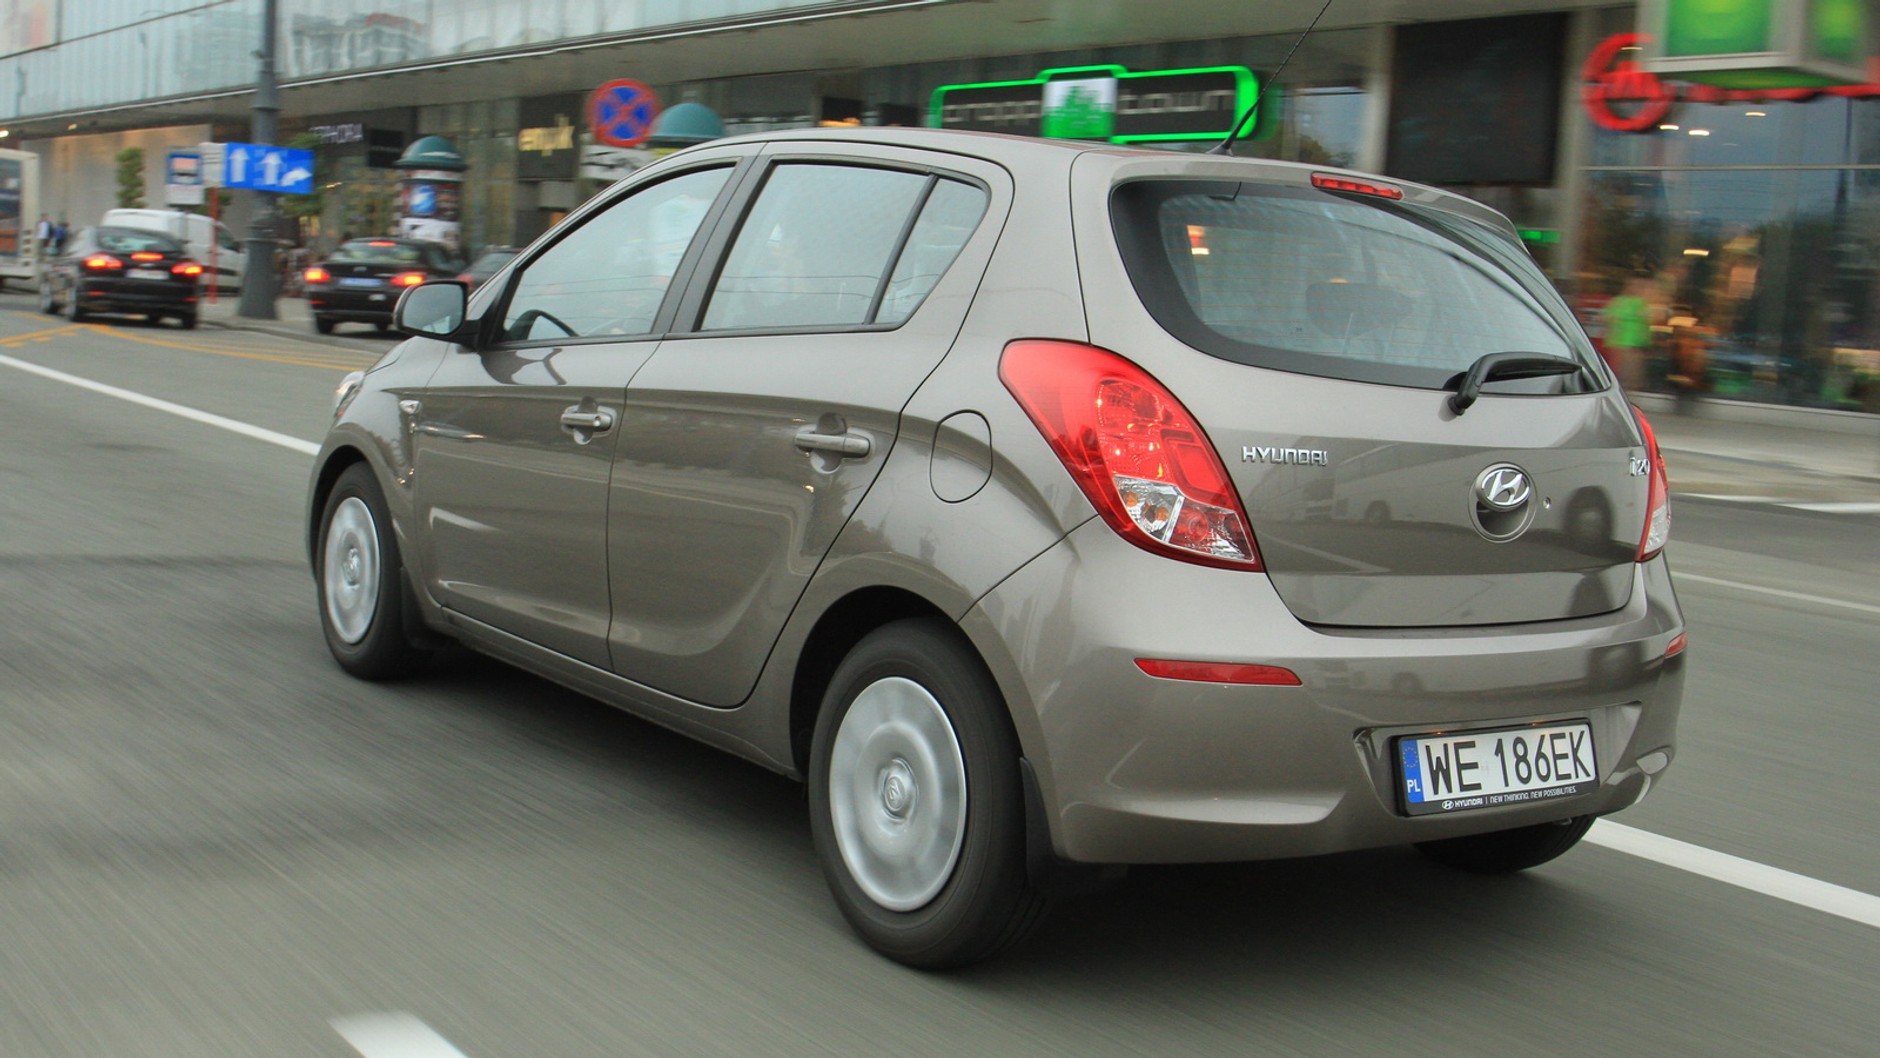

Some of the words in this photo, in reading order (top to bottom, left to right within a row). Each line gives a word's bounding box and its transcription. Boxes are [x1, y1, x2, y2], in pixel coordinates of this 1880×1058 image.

[1241, 446, 1329, 466] HYUNDAI
[1425, 740, 1482, 796] WE
[1494, 730, 1591, 788] 186EK
[1406, 779, 1421, 793] PL
[1454, 798, 1483, 808] HYUNDAI
[1489, 796, 1503, 804] NEW
[1530, 791, 1543, 799] NEW
